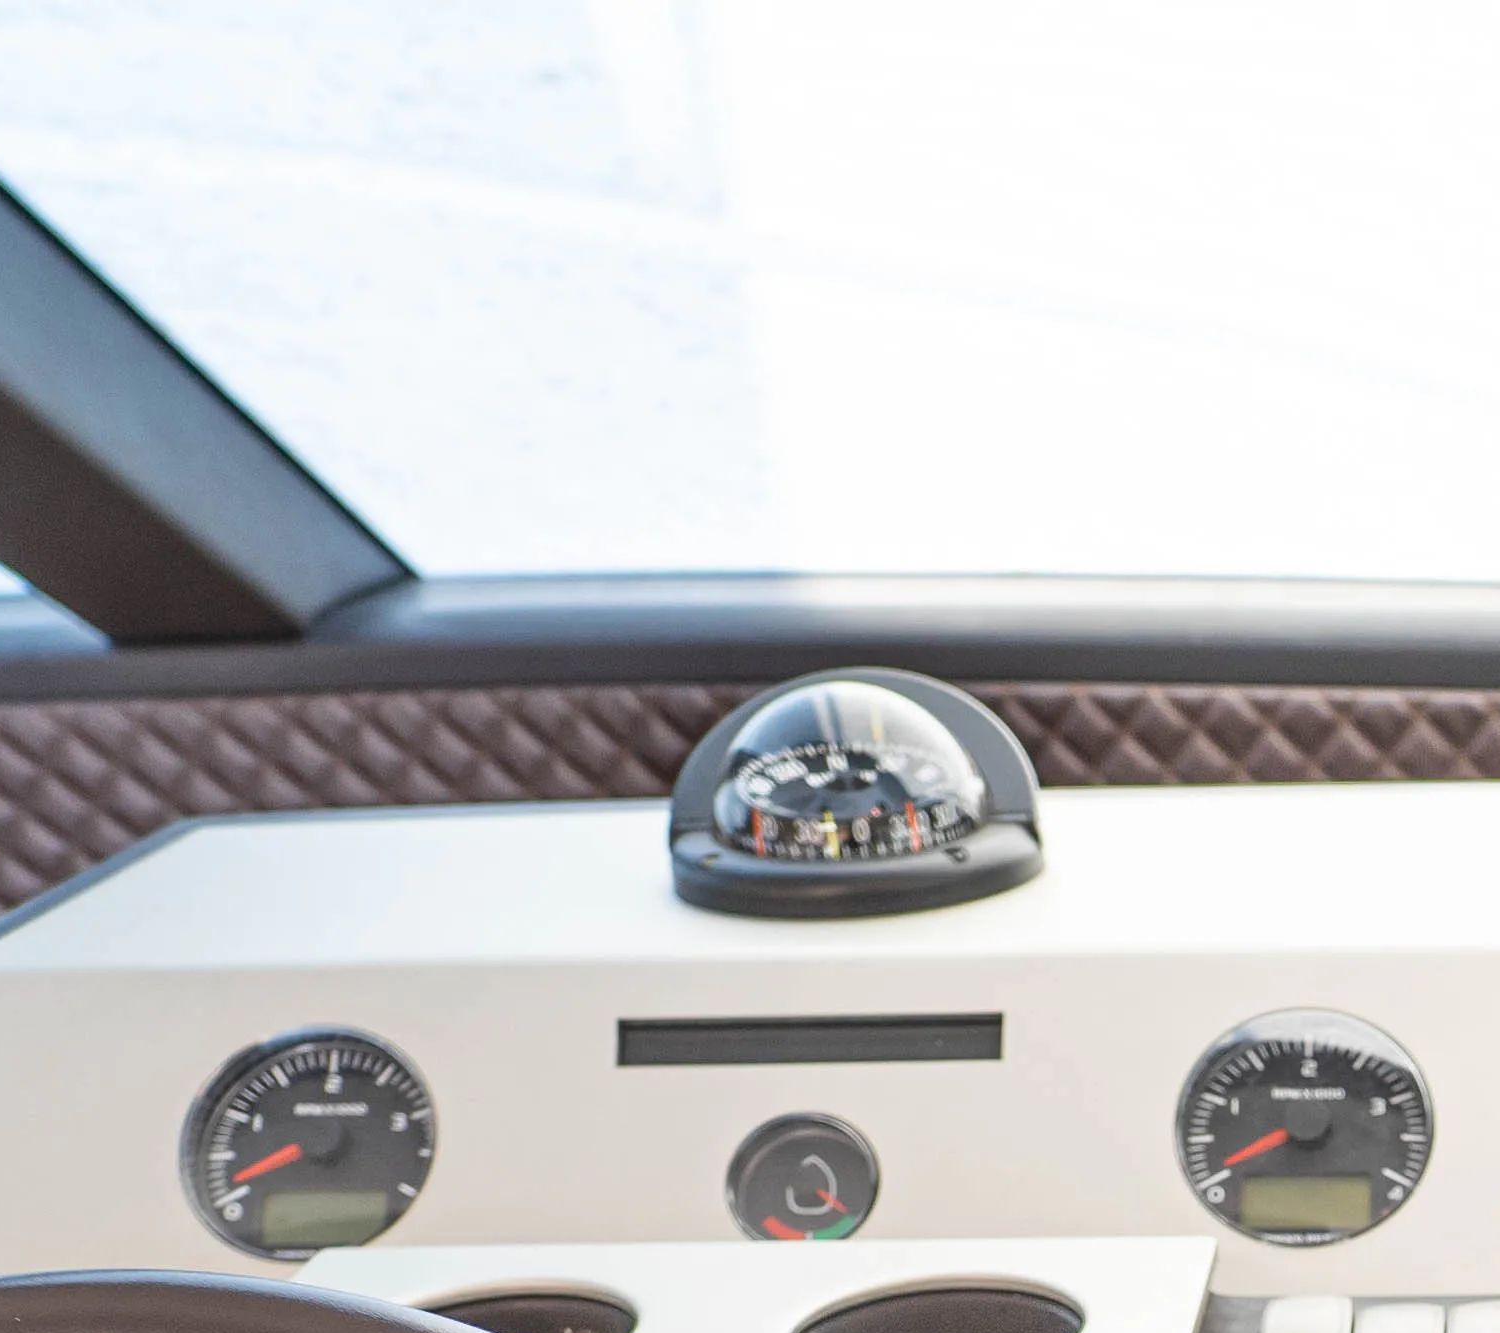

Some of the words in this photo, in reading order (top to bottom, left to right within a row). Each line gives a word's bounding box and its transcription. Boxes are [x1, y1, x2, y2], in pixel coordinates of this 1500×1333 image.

[1370, 1097, 1387, 1116] 3
[1206, 1186, 1225, 1203] 0
[223, 1203, 244, 1222] 0
